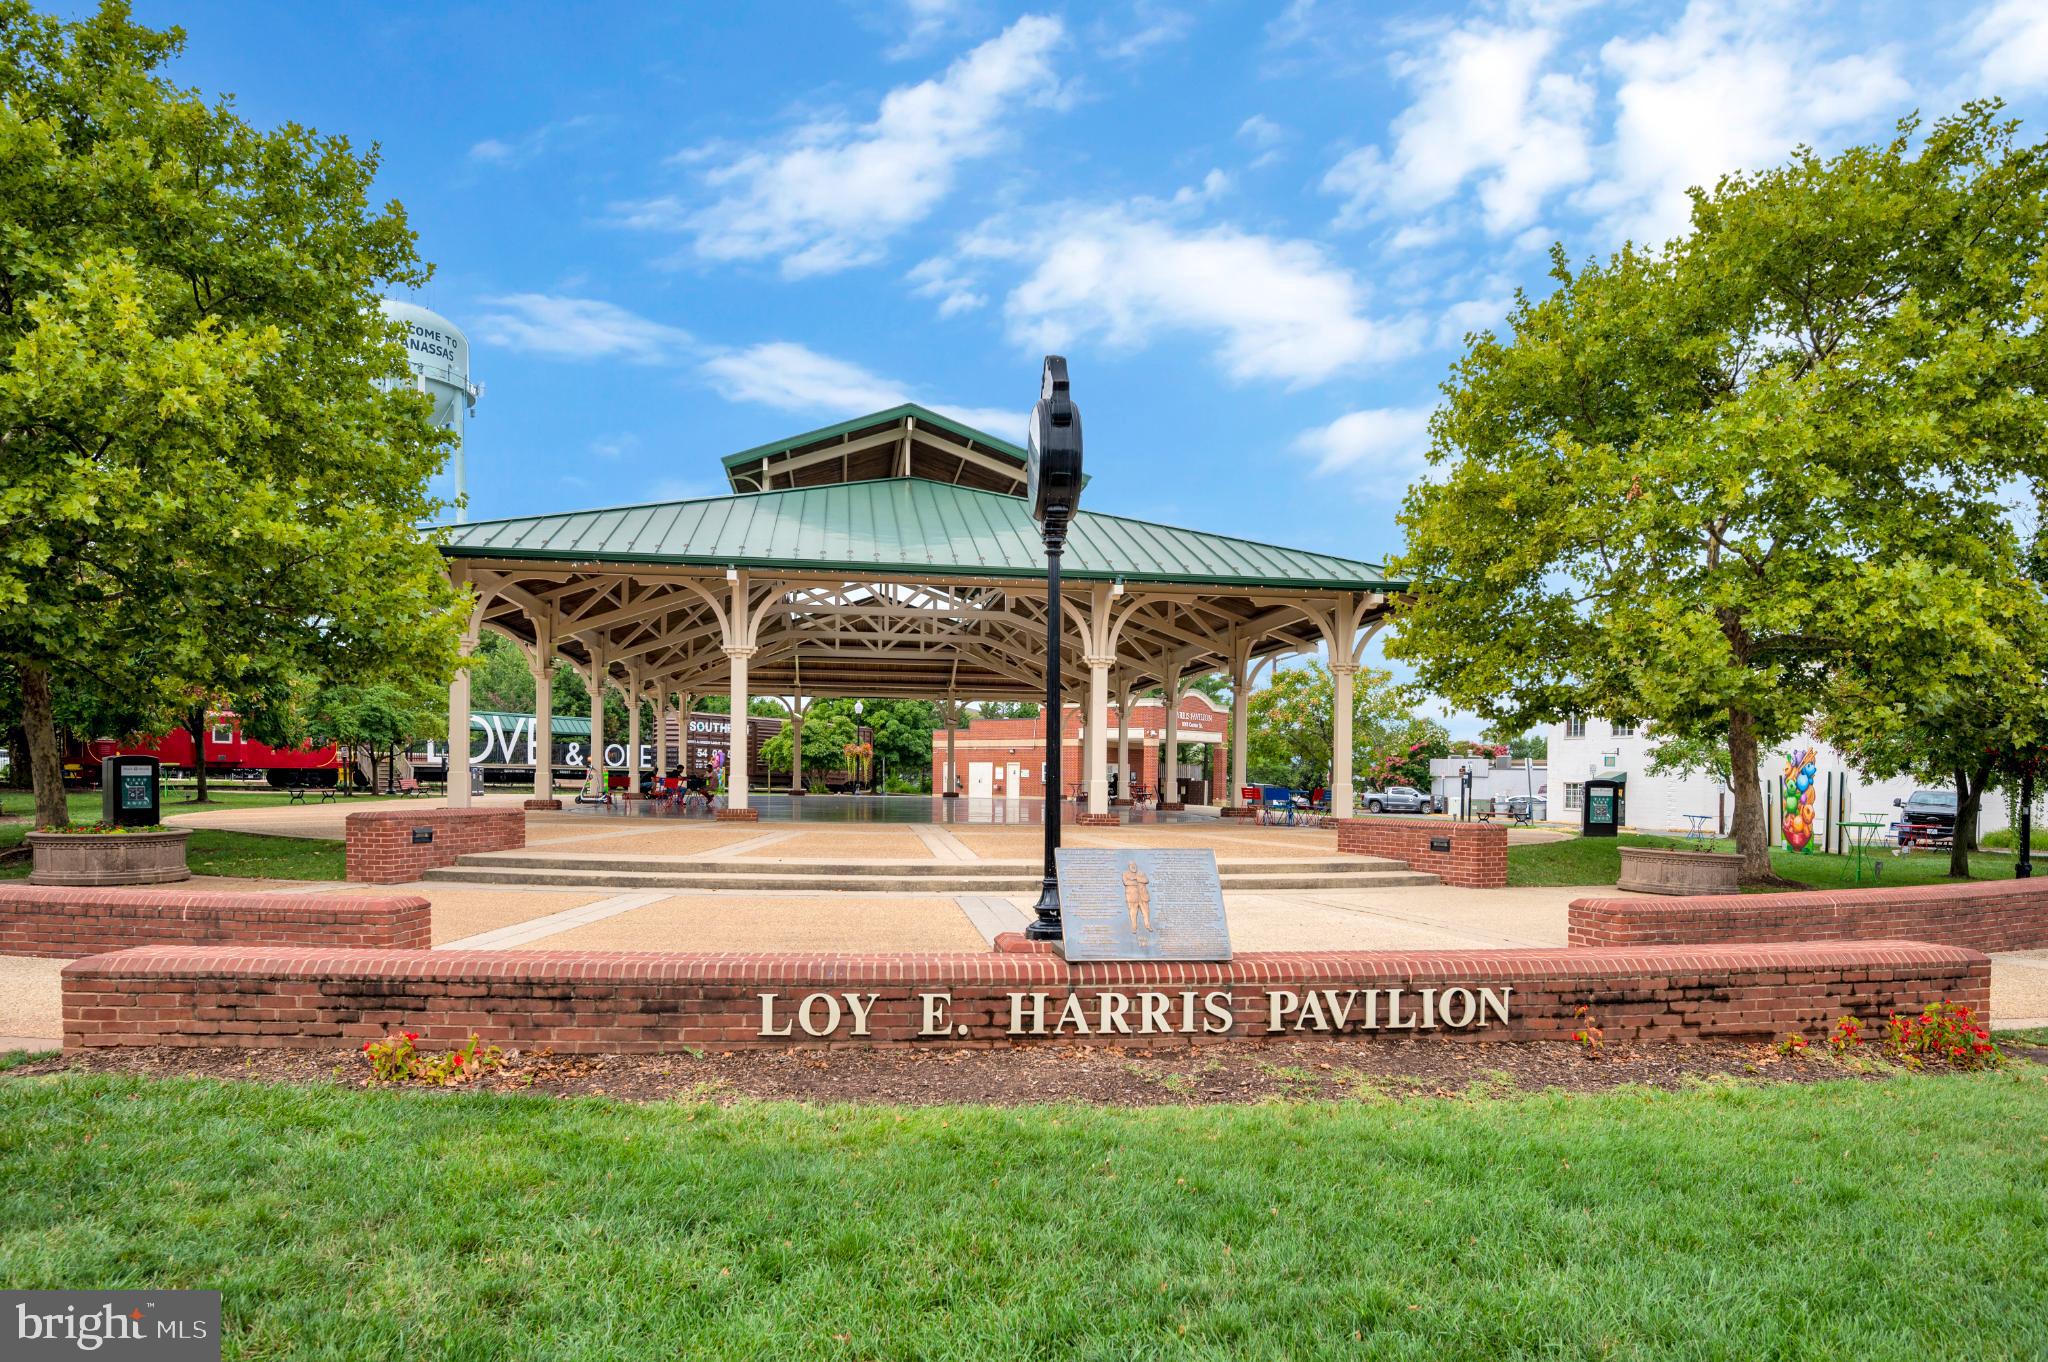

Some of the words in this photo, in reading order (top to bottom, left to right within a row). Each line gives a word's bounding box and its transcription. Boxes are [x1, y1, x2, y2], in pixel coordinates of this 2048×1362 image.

[407, 324, 441, 342] COME
[445, 335, 458, 349] TO
[401, 338, 454, 361] ANASSAS
[565, 742, 584, 766] &
[756, 993, 880, 1037] LOY
[918, 993, 969, 1036] E.
[1005, 991, 1233, 1035] HARRIS
[1265, 987, 1514, 1031] PAVILION
